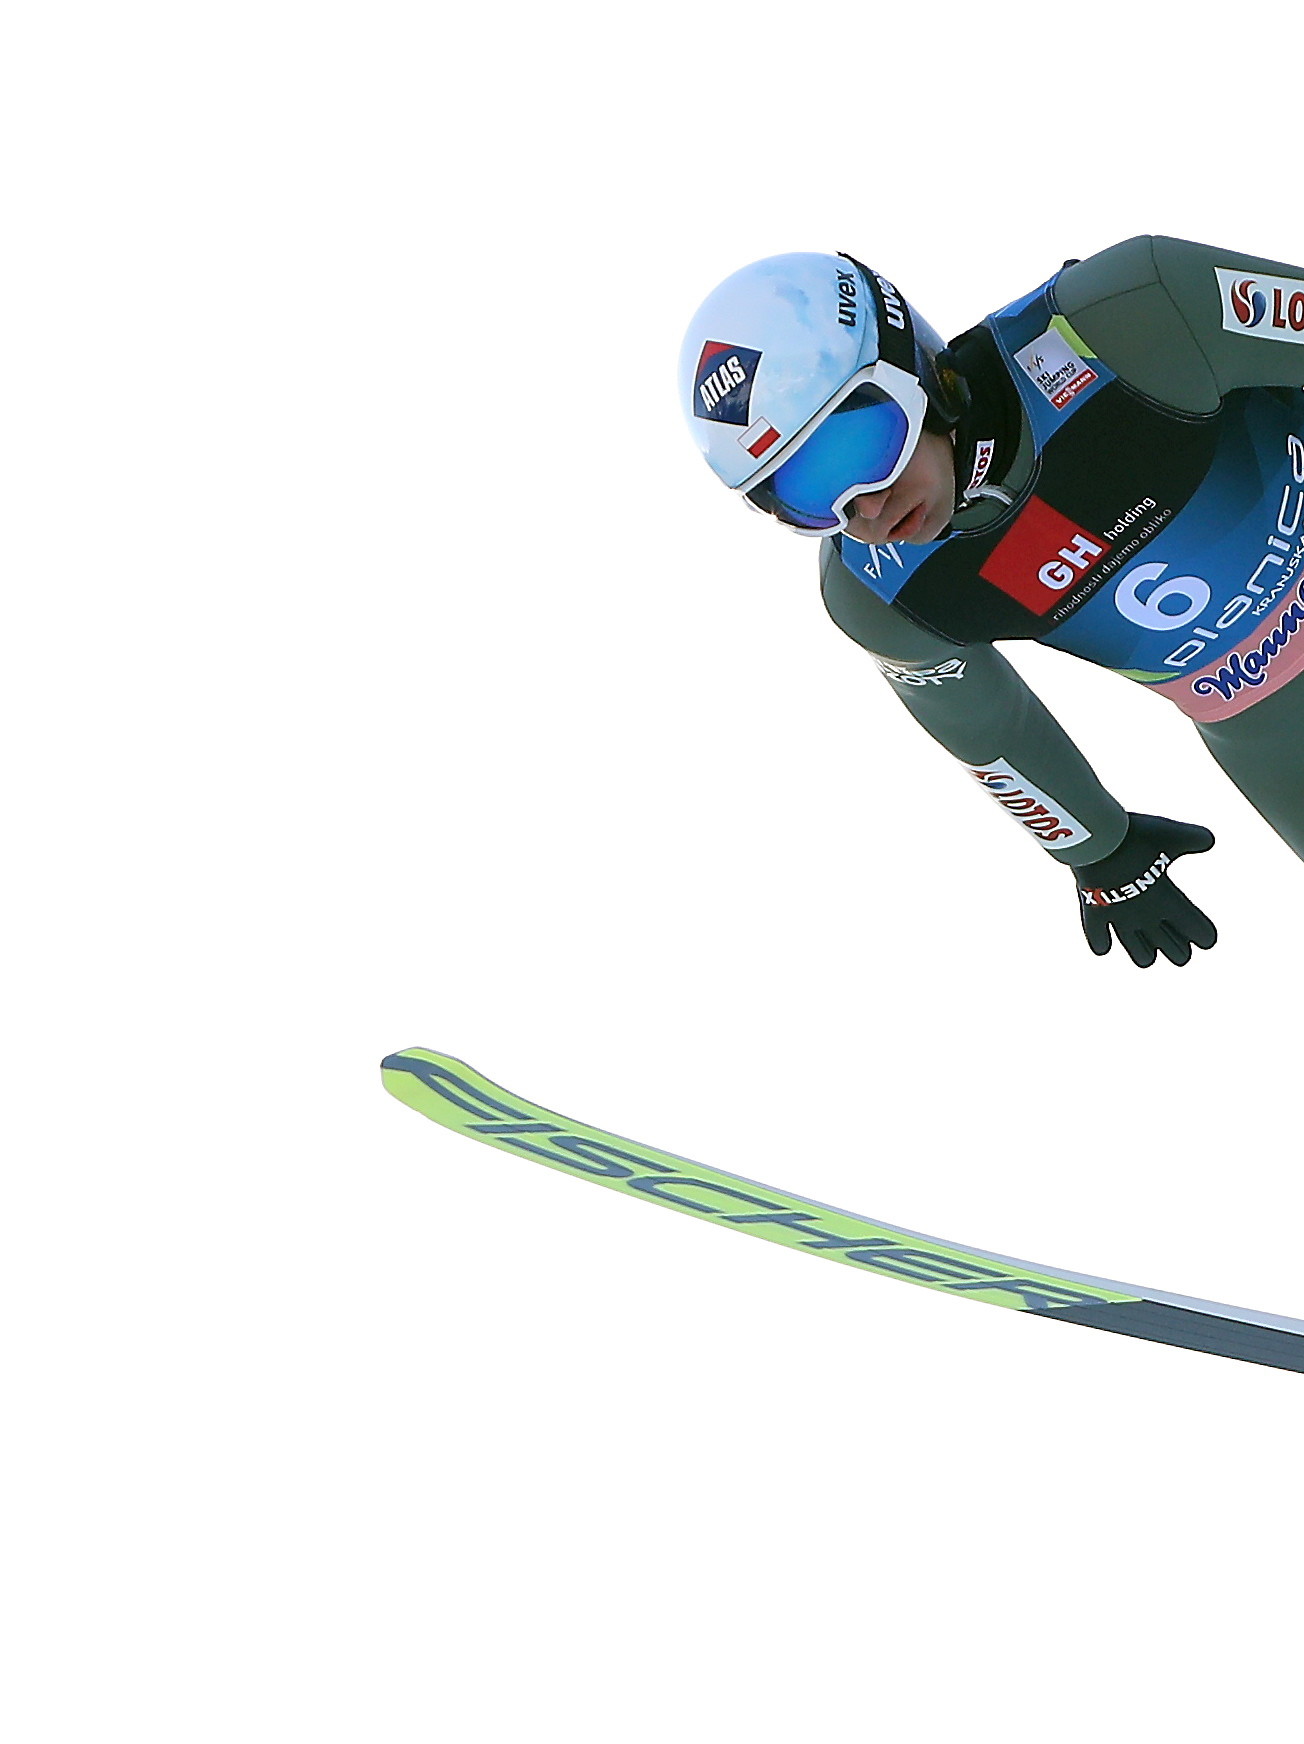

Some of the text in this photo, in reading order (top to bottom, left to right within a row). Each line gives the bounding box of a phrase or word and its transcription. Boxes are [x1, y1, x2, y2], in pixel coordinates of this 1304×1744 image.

[837, 267, 857, 327] uvex
[699, 354, 747, 412] ATLAS
[969, 446, 991, 490] OTOS
[1038, 497, 1157, 591] GH holding
[1050, 572, 1102, 622] rihodnosti
[1139, 508, 1172, 539] obliko
[1114, 561, 1211, 632] 6
[381, 1053, 1108, 1311] FISCHER
